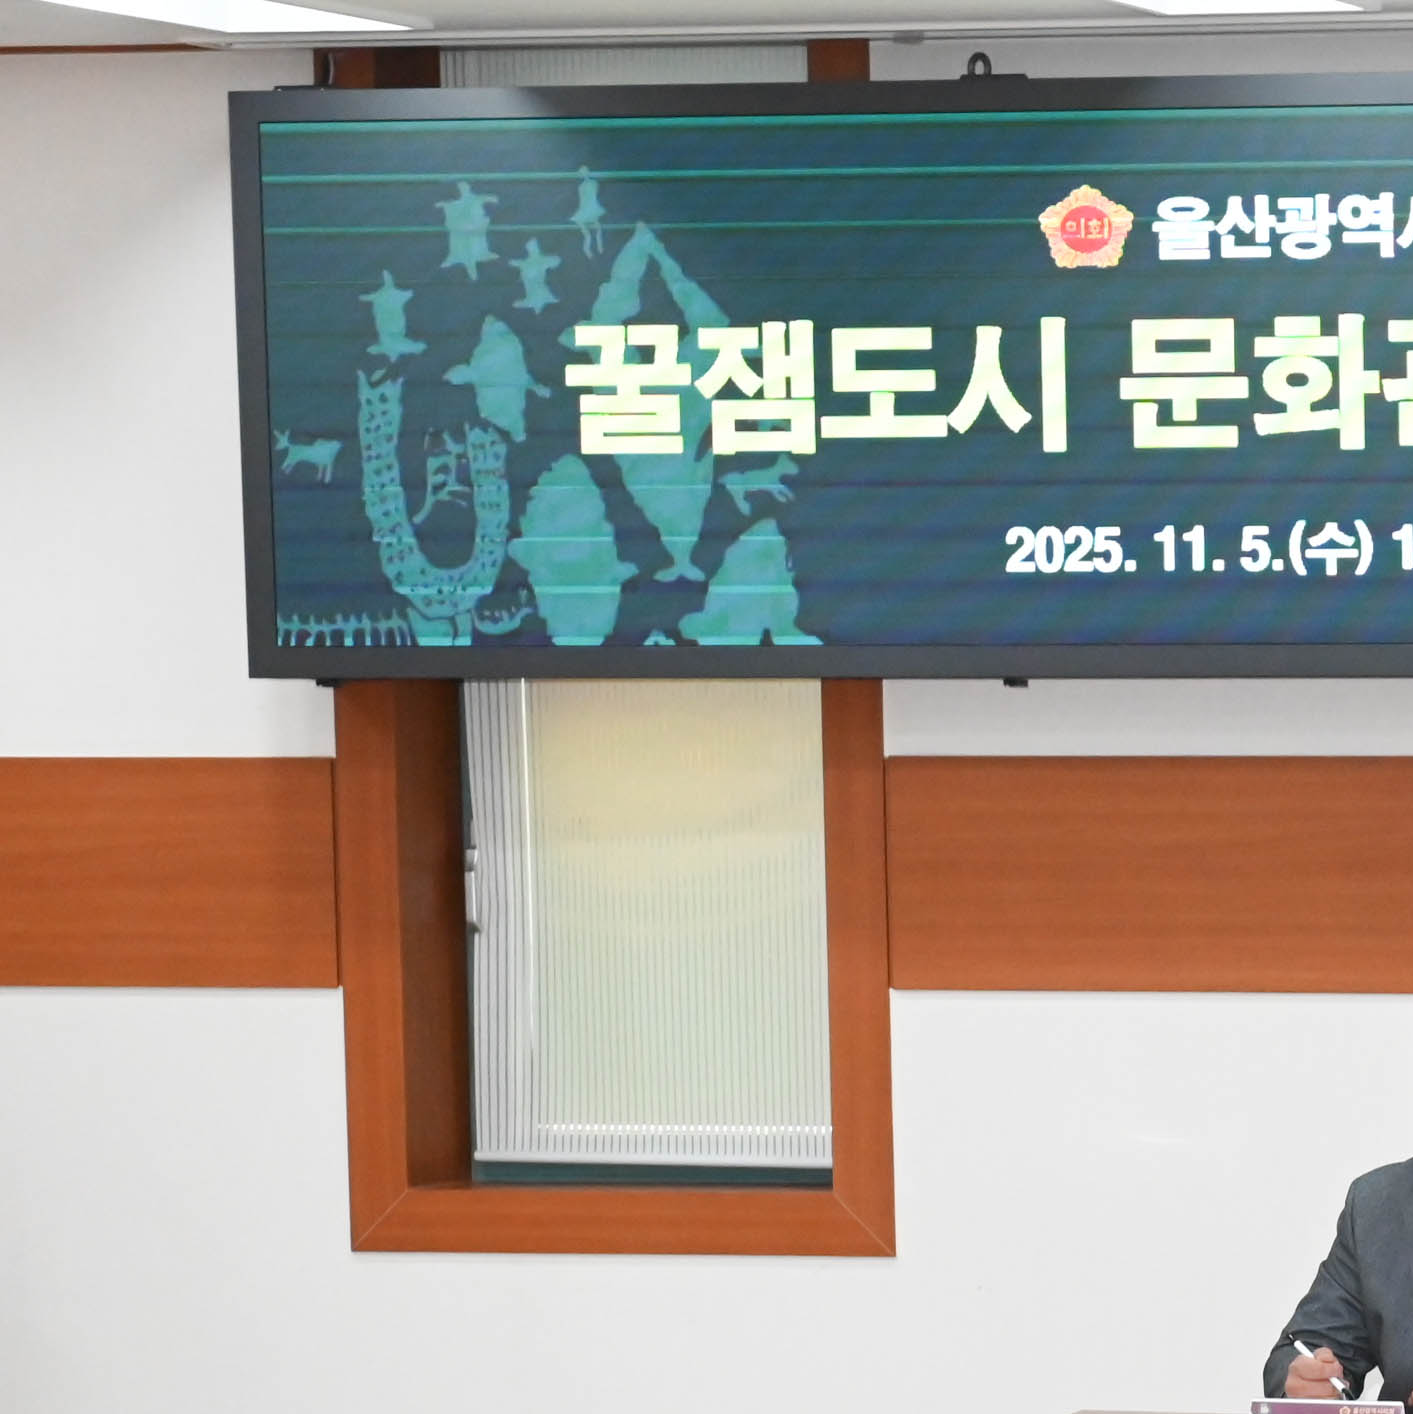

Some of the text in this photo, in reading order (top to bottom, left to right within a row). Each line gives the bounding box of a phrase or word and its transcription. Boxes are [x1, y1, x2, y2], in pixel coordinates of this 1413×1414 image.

[565, 317, 1067, 455] 꿀잼도시
[1006, 526, 1136, 573] 2025.
[1154, 525, 1224, 571] 11.
[1240, 520, 1373, 575] 5.(수)
